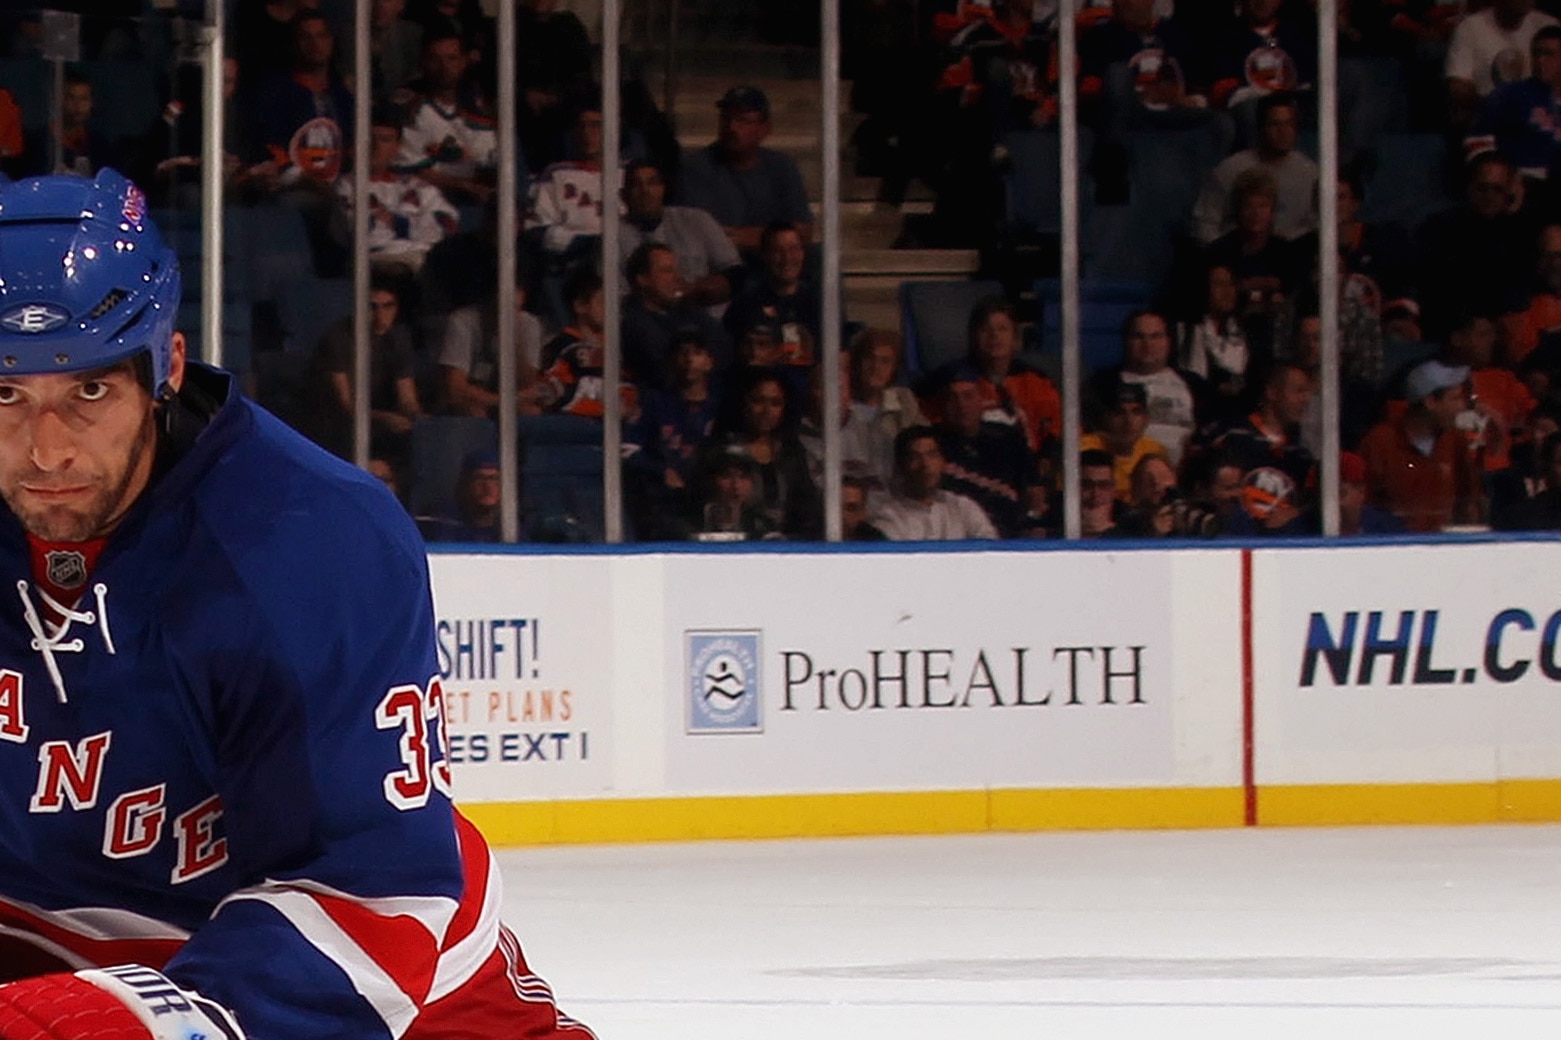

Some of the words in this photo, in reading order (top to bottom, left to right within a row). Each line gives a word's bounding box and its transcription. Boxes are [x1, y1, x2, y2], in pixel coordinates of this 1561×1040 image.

[438, 618, 539, 680] SHIFT!
[779, 644, 1148, 711] ProHEALTH
[488, 689, 573, 723] PLANS
[500, 731, 570, 762] EXT
